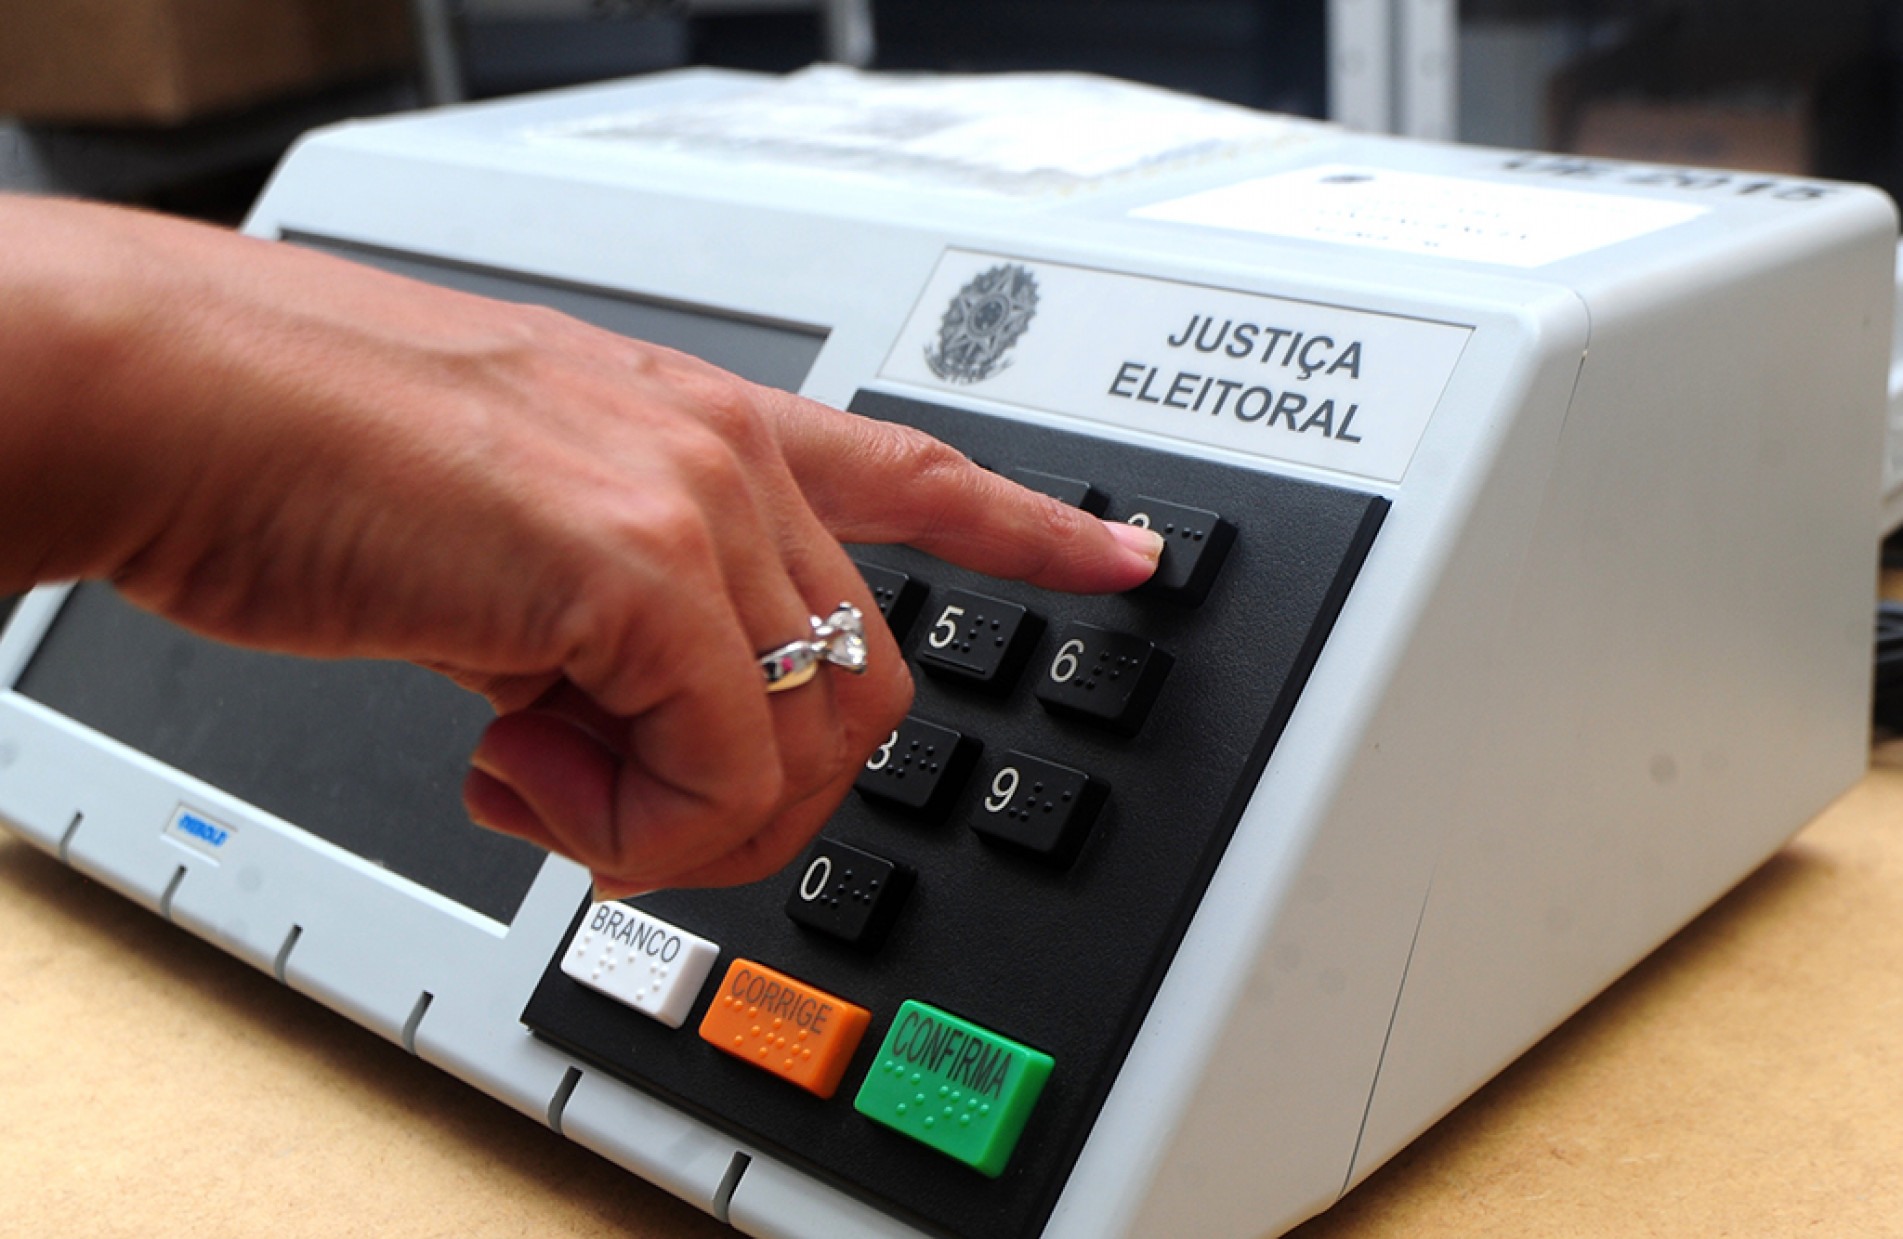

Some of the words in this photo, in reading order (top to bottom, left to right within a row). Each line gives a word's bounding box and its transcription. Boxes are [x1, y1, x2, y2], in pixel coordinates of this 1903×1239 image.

[1167, 315, 1363, 380] JUSTIÇA
[1108, 361, 1363, 444] ELEITORAL
[928, 605, 964, 649] 5
[1050, 638, 1084, 683] 6
[984, 767, 1020, 813] 9
[800, 856, 831, 901] 0
[590, 904, 681, 963] BRANCO
[732, 969, 832, 1035] CORRIGE
[893, 1010, 1012, 1100] CONFIRMA
